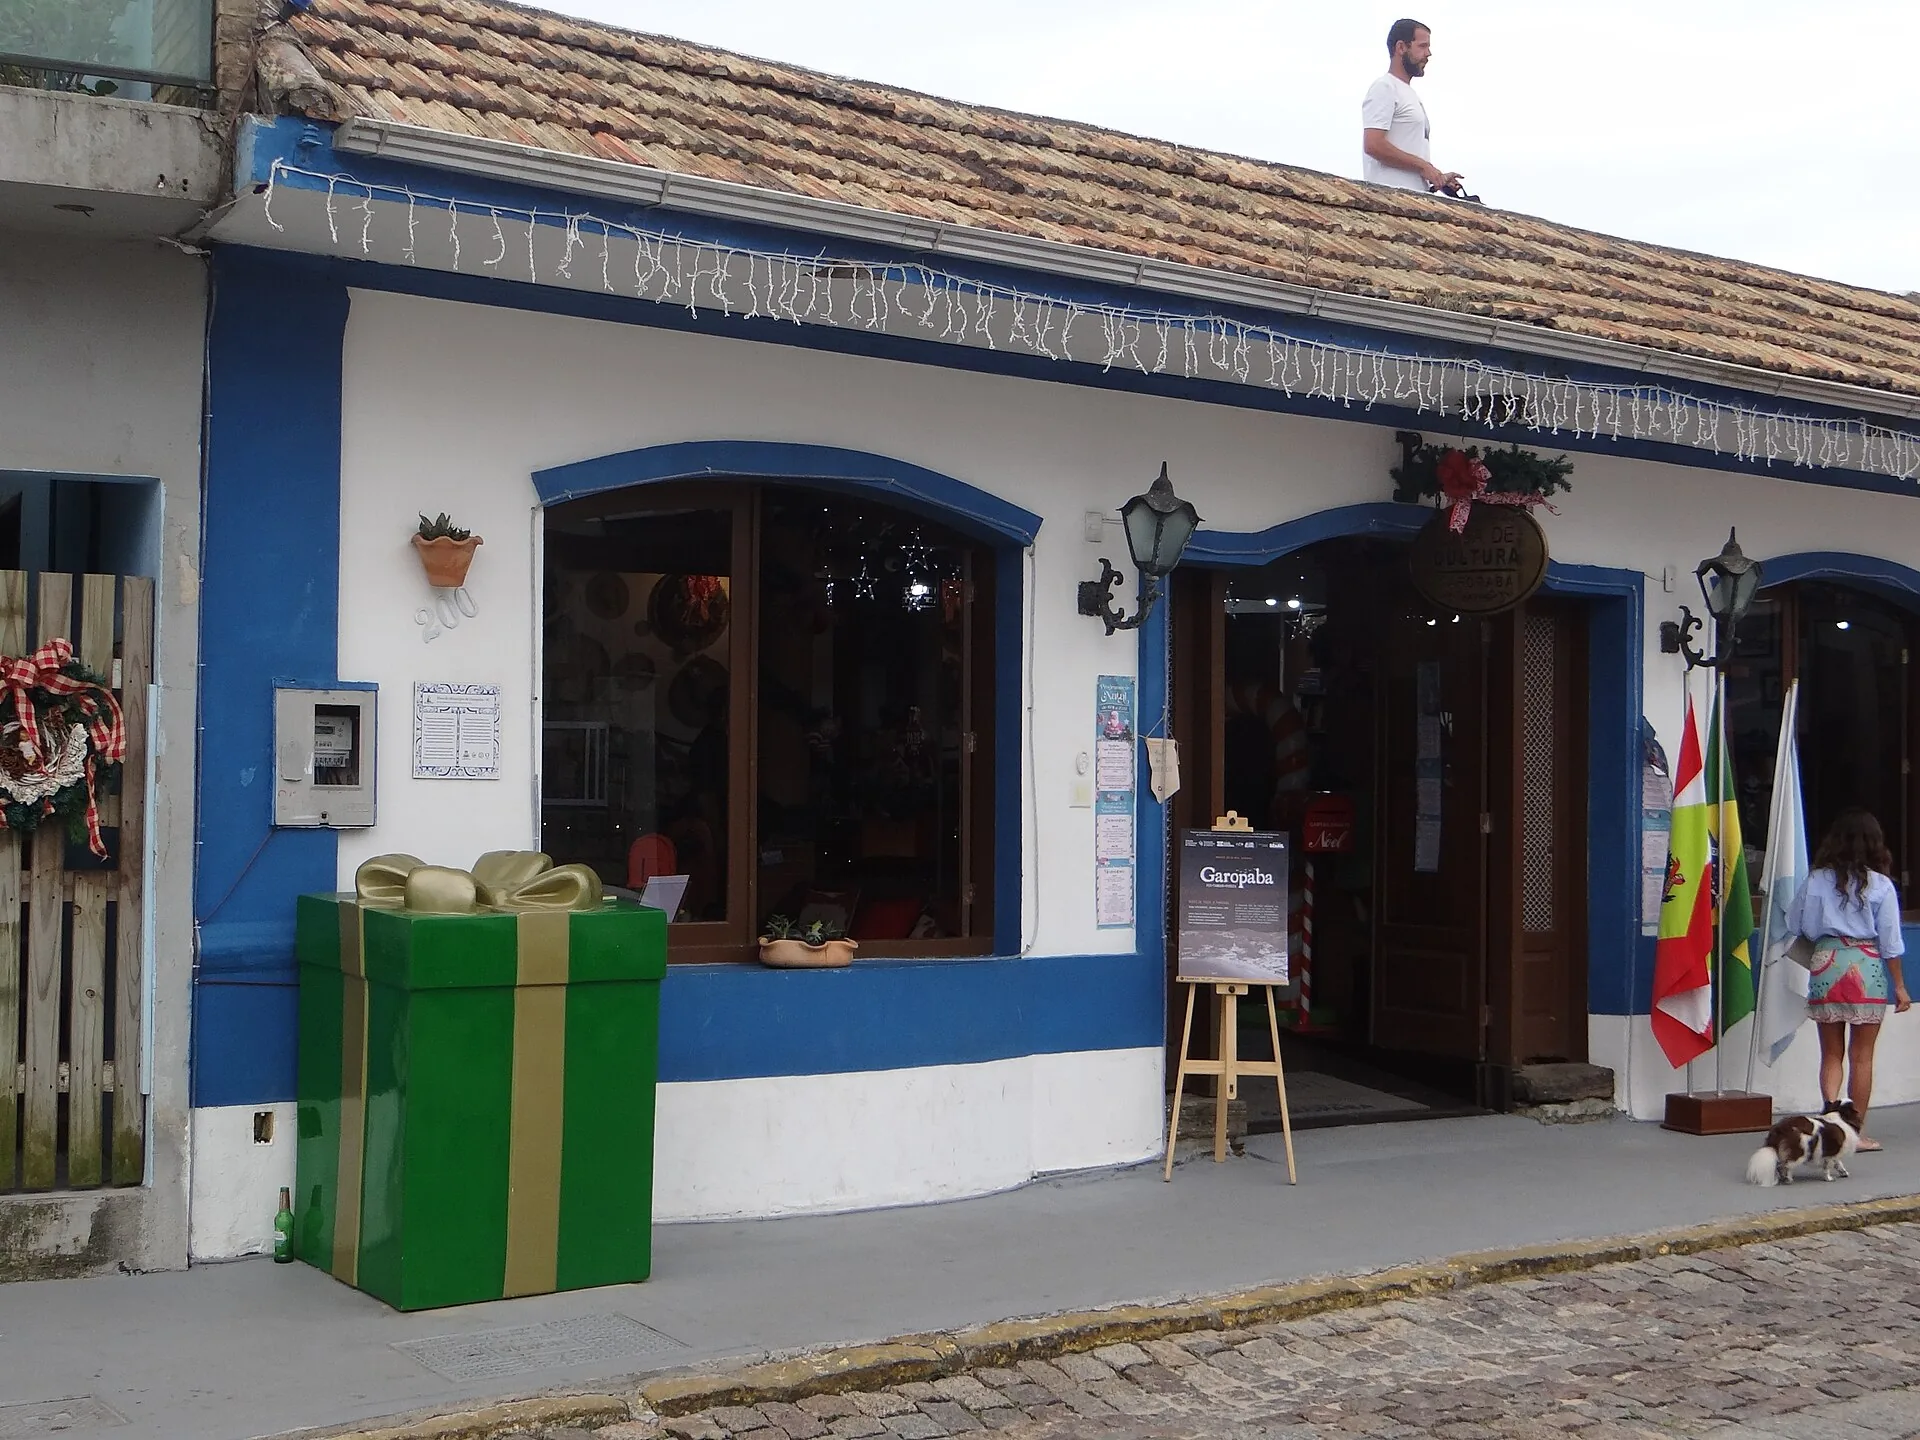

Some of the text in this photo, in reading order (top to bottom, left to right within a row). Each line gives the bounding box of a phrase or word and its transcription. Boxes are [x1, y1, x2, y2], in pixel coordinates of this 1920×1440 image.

[1491, 526, 1514, 543] DE
[1433, 548, 1519, 566] CULTURA
[1200, 866, 1274, 888] Garopaba
